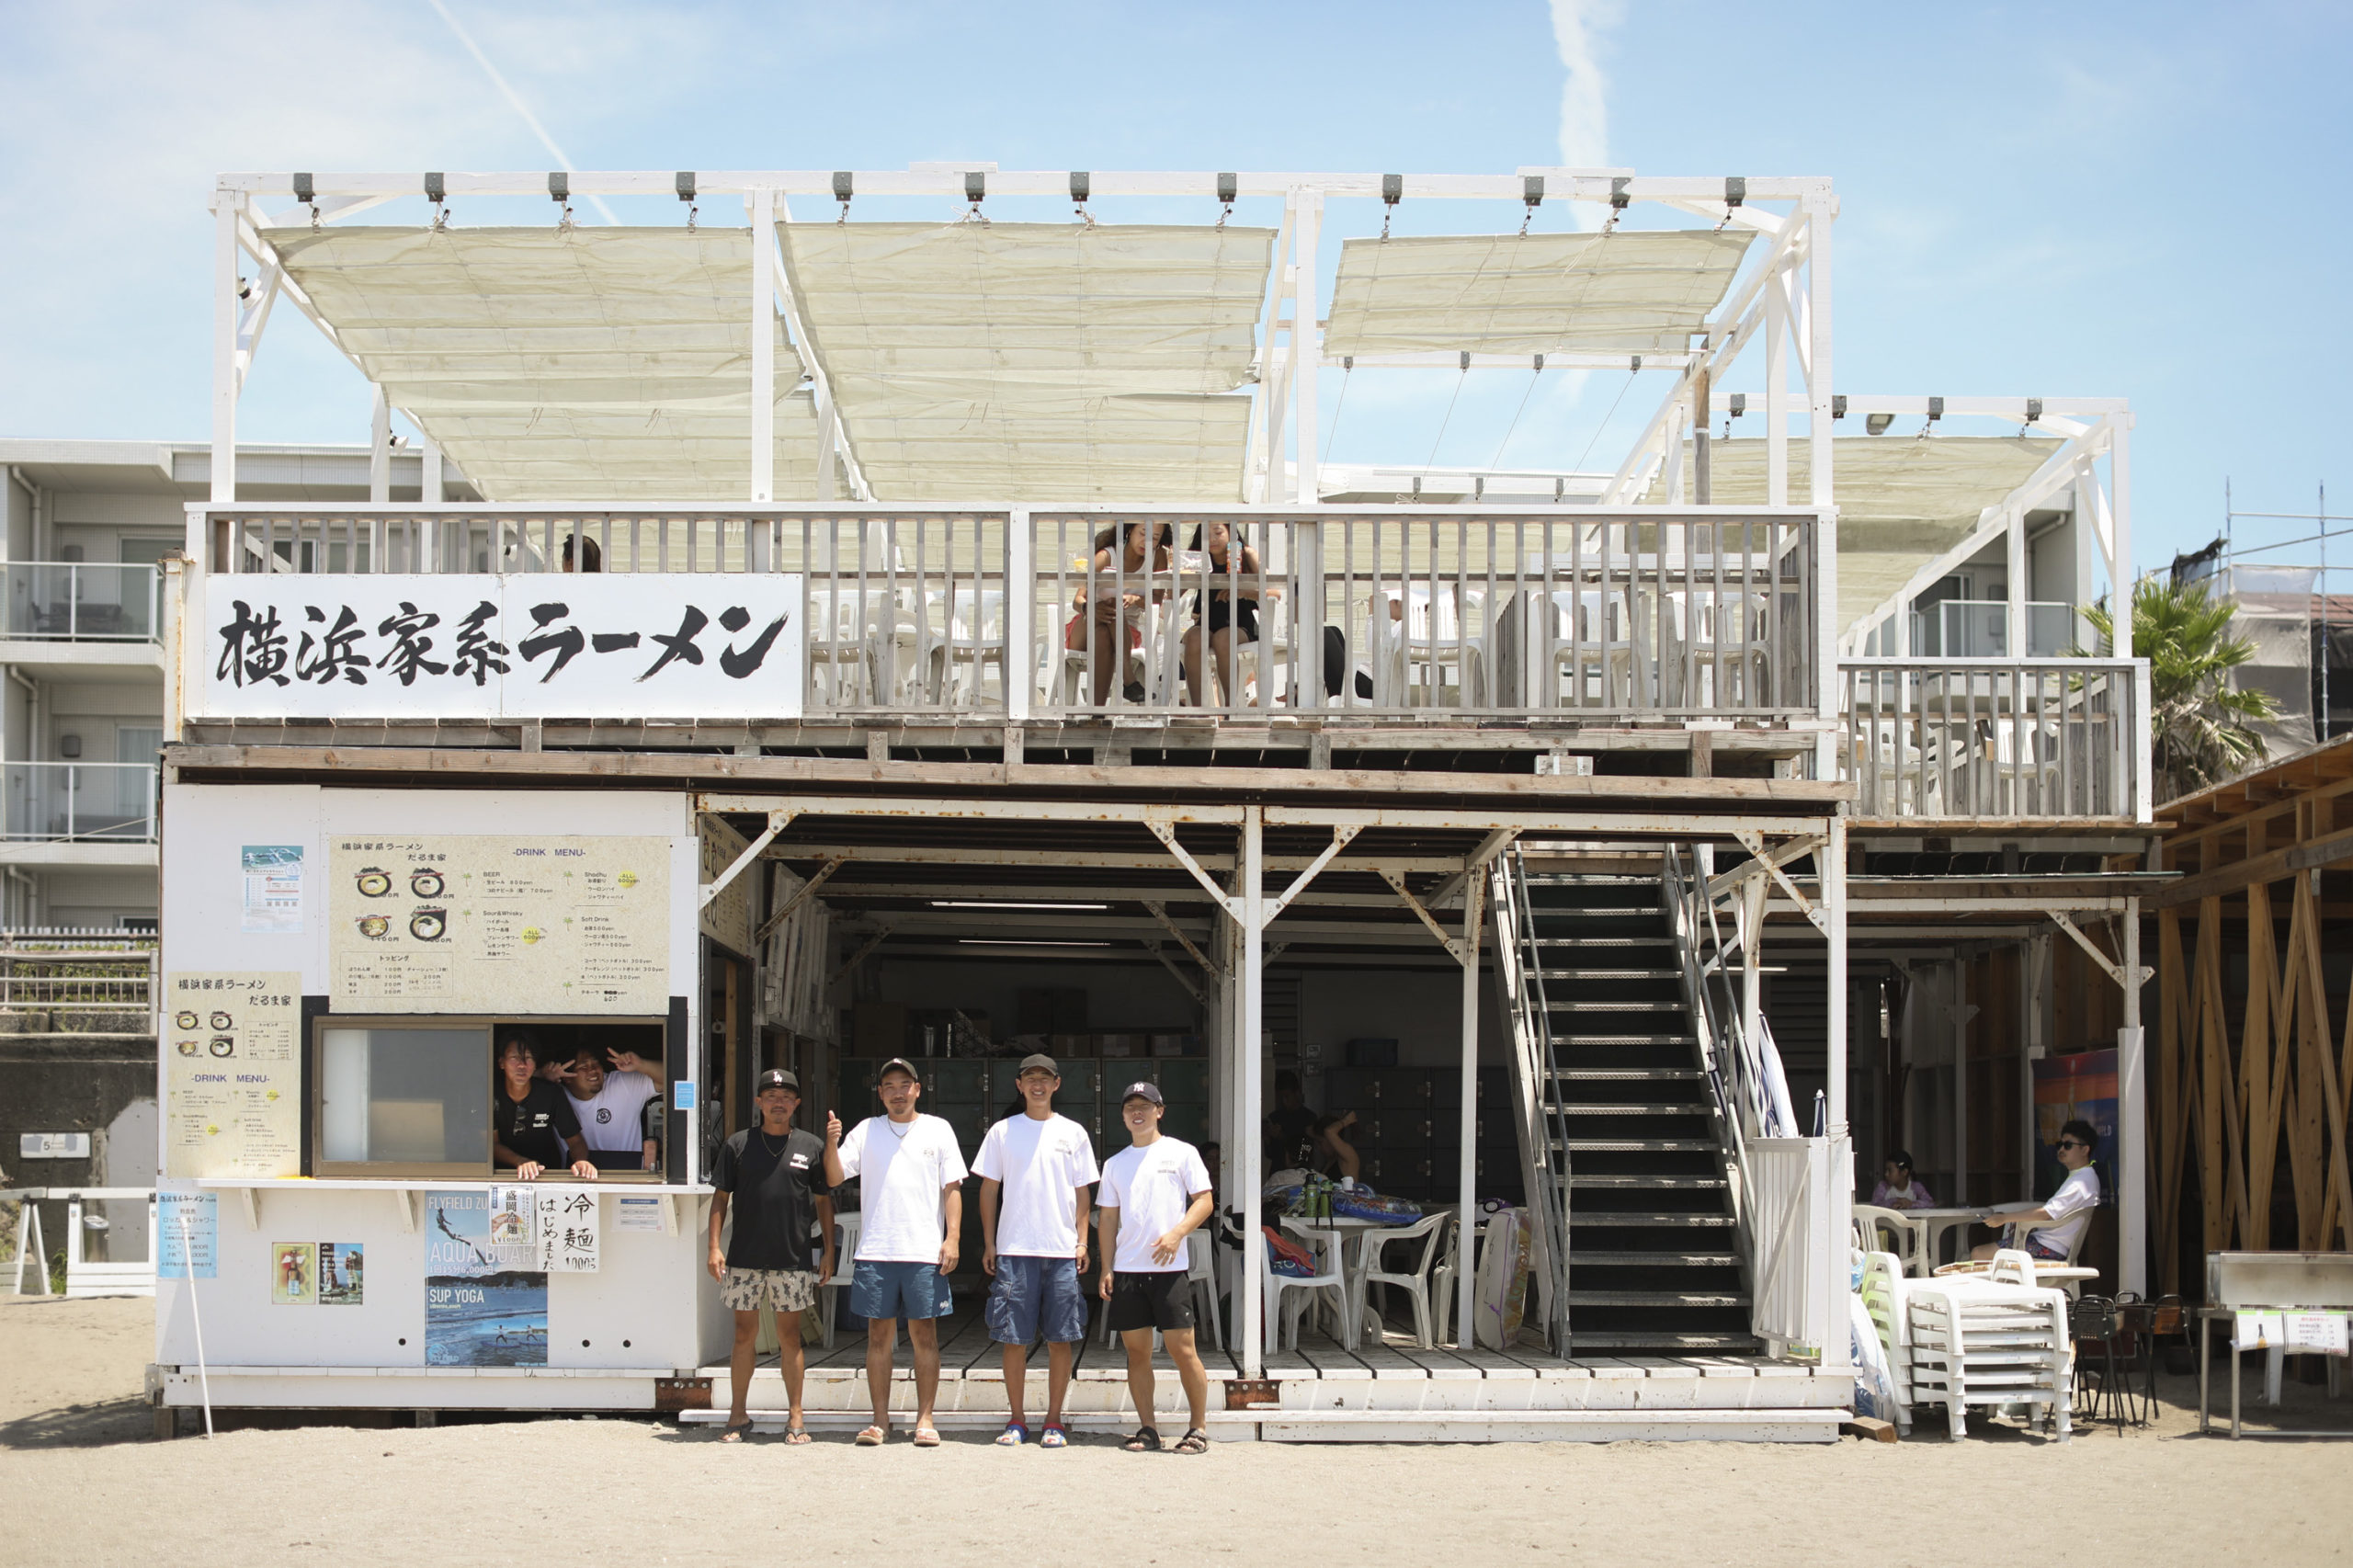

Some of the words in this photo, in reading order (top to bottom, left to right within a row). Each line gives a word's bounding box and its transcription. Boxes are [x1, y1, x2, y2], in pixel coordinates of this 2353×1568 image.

[216, 599, 792, 687] 横浜家系ラーメン
[341, 842, 424, 851] 横浜家系ラーメン
[407, 853, 447, 861] だるま家
[178, 979, 267, 990] 横浜家系ラーメン
[249, 994, 291, 1006] だるま家
[428, 1197, 472, 1210] FLYFIELD
[563, 1193, 596, 1253] 冷麺
[540, 1199, 558, 1270] はじめました
[430, 1242, 478, 1264] AQUA
[429, 1289, 451, 1303] SUP
[455, 1289, 485, 1303] YOGA
